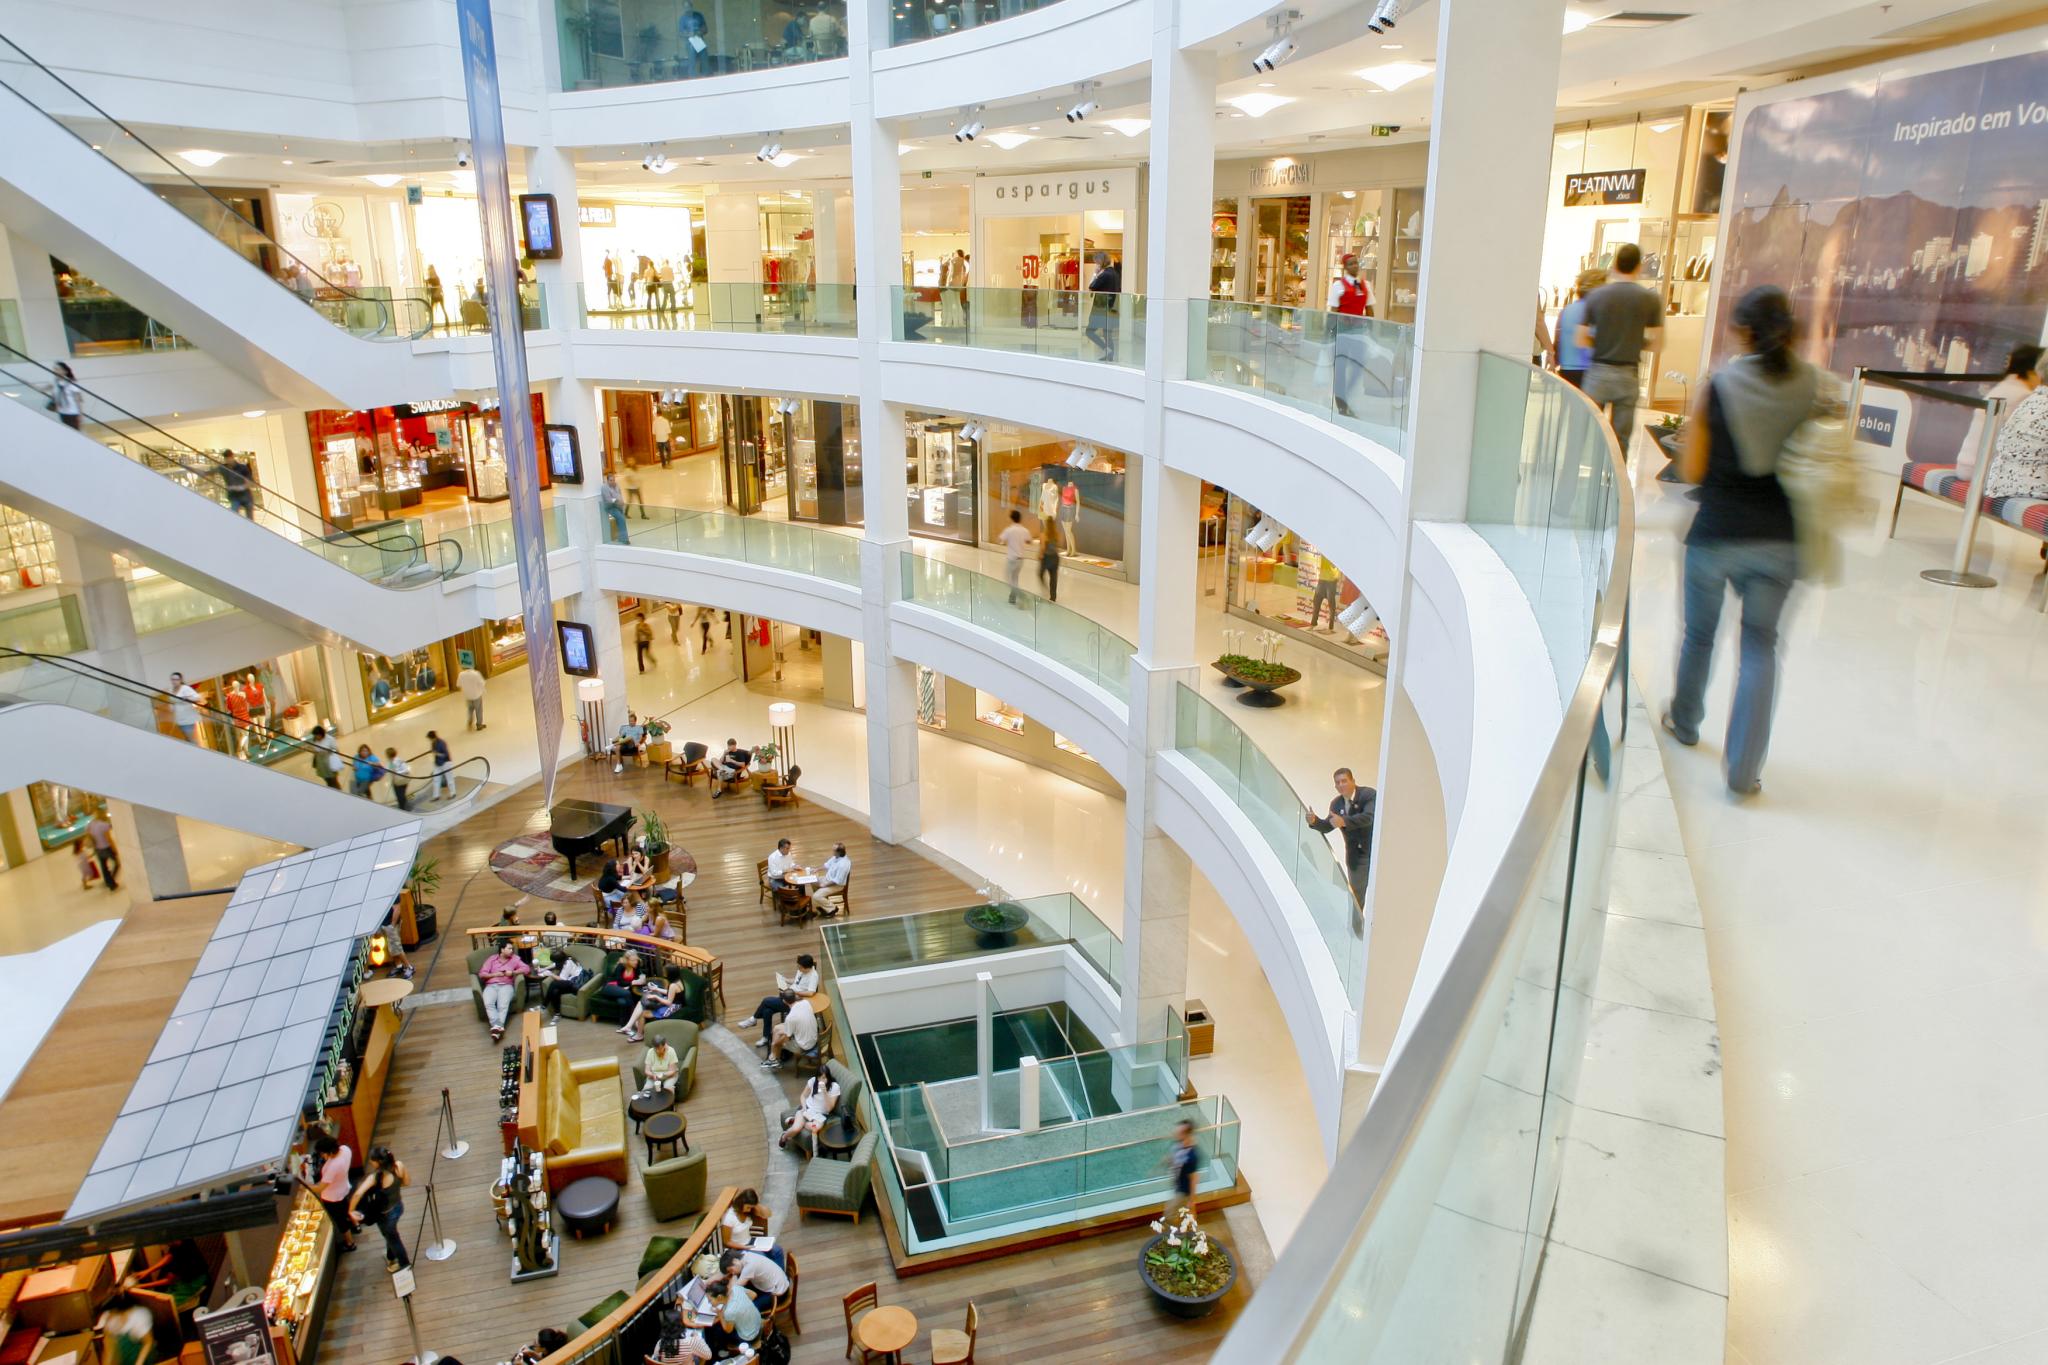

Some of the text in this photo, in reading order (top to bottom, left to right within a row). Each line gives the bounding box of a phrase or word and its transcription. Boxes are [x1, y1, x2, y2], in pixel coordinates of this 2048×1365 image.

[1894, 102, 2048, 144] Inspirado em Vo
[996, 180, 1110, 201] aspargus
[1569, 174, 1636, 194] PLATINVM
[410, 400, 460, 414] SWAROVSKI
